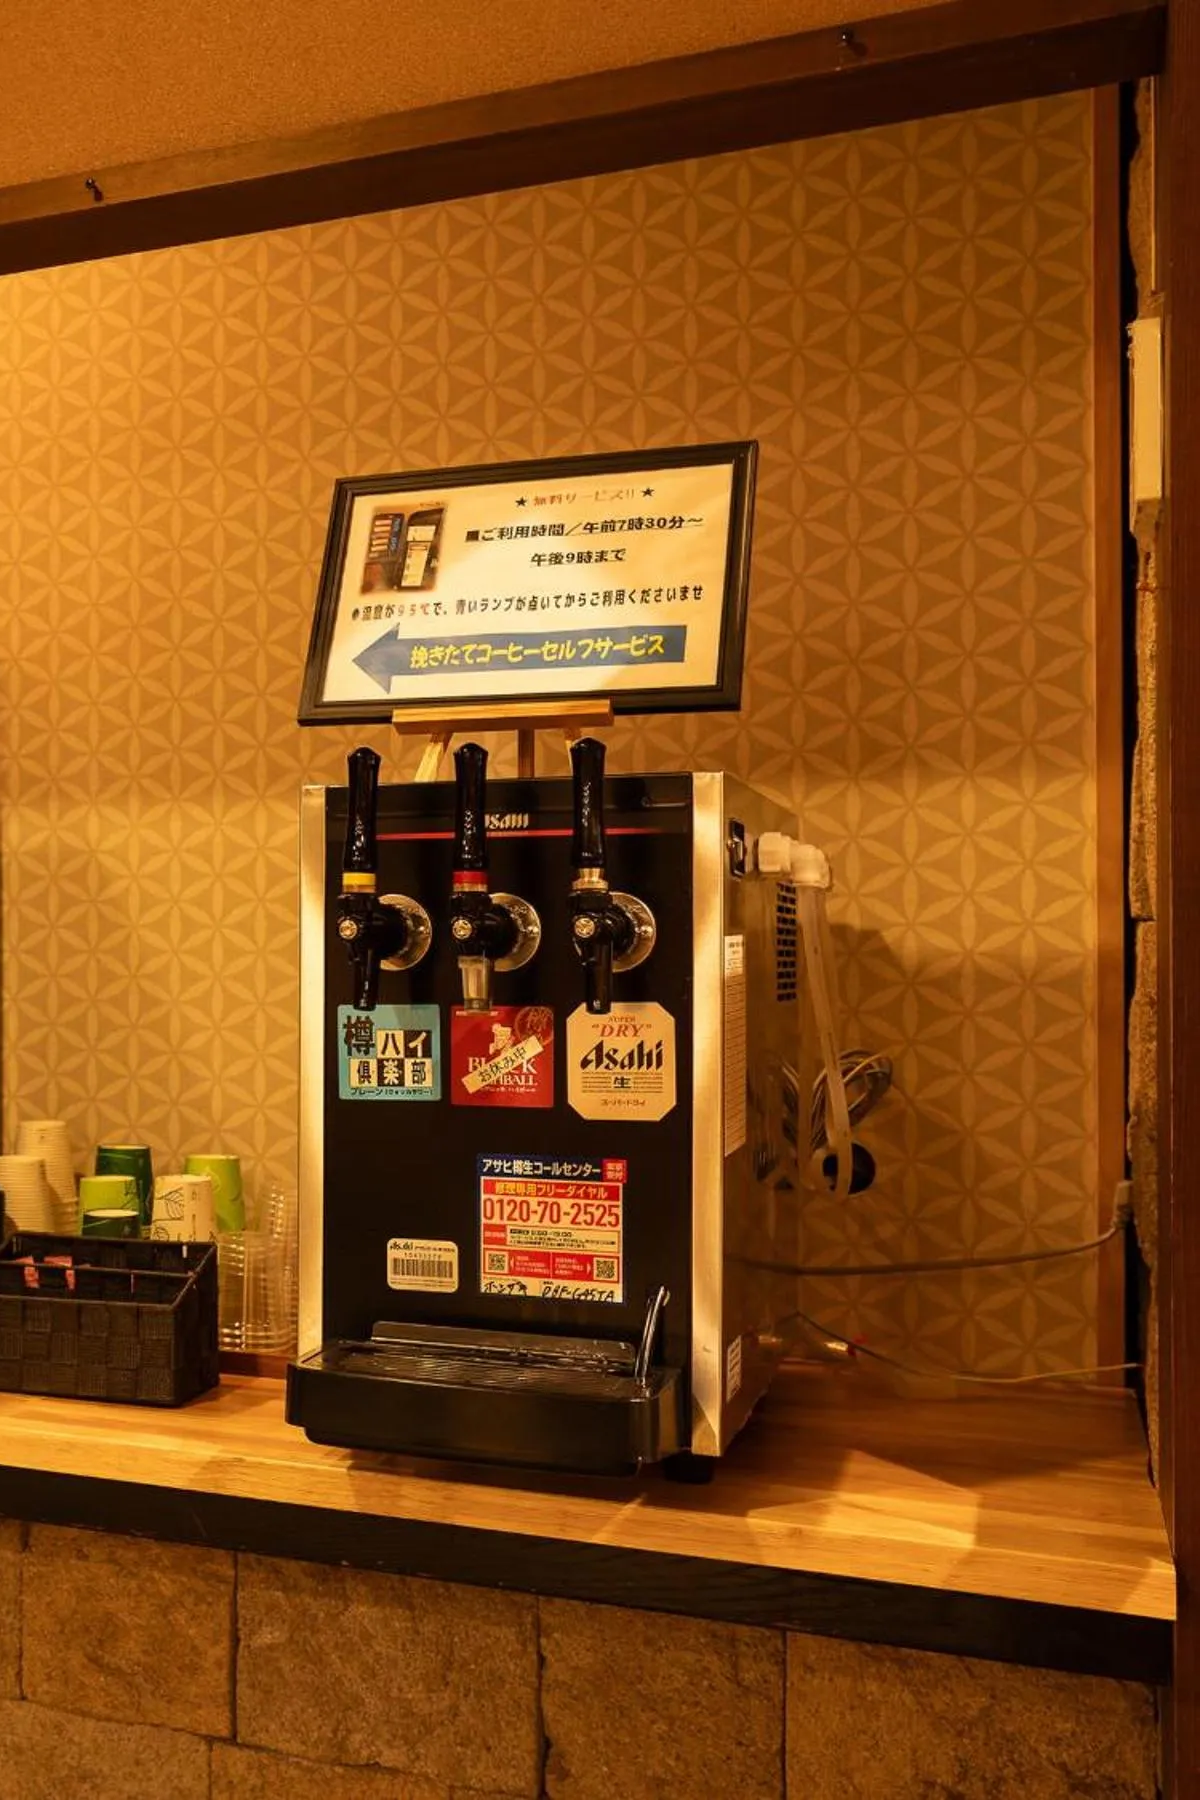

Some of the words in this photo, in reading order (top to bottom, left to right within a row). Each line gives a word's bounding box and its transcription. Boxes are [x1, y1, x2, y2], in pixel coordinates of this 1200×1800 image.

[530, 548, 627, 567] 午後9時まで
[410, 635, 665, 669] 挽きたてコーヒーセルフサービス
[484, 813, 529, 829] sahi
[580, 1039, 664, 1071] Asahi
[613, 1076, 633, 1089] 生
[483, 1198, 620, 1228] 0120-70-2525
